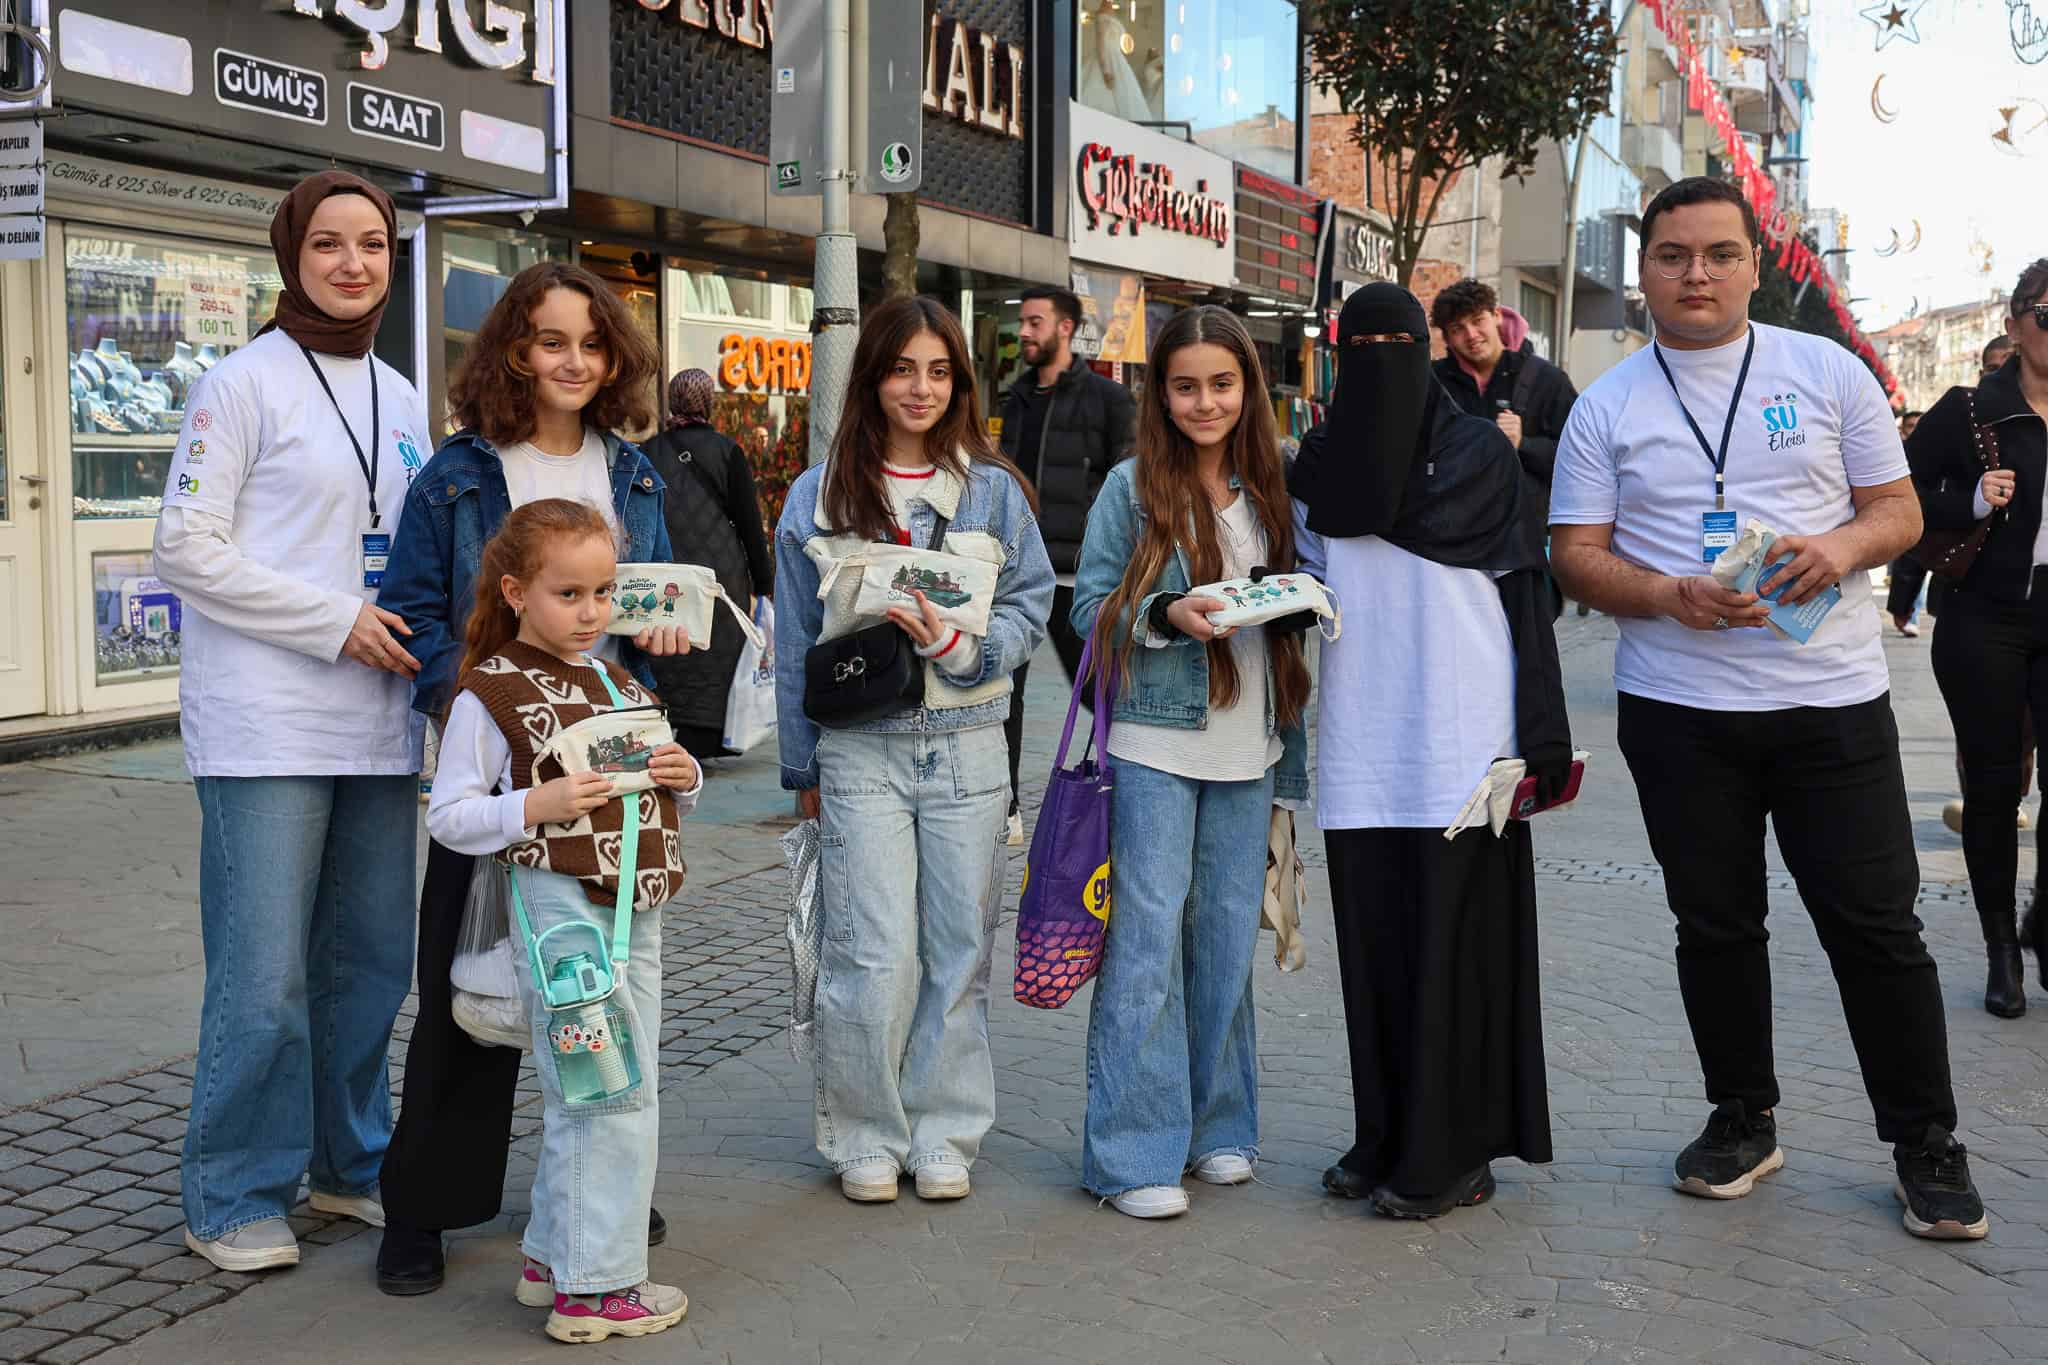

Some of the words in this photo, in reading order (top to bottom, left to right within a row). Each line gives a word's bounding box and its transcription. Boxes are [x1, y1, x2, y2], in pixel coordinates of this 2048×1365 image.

[223, 60, 319, 117] GÜMÜŞ
[362, 94, 433, 139] SAAT
[52, 162, 99, 184] Gümüş
[99, 174, 113, 188] &
[117, 175, 147, 193] 925
[147, 180, 183, 200] Silver
[183, 186, 195, 200] &
[200, 187, 226, 204] 925
[228, 192, 266, 212] Gümüş
[198, 318, 218, 335] 100
[222, 319, 237, 337] TL
